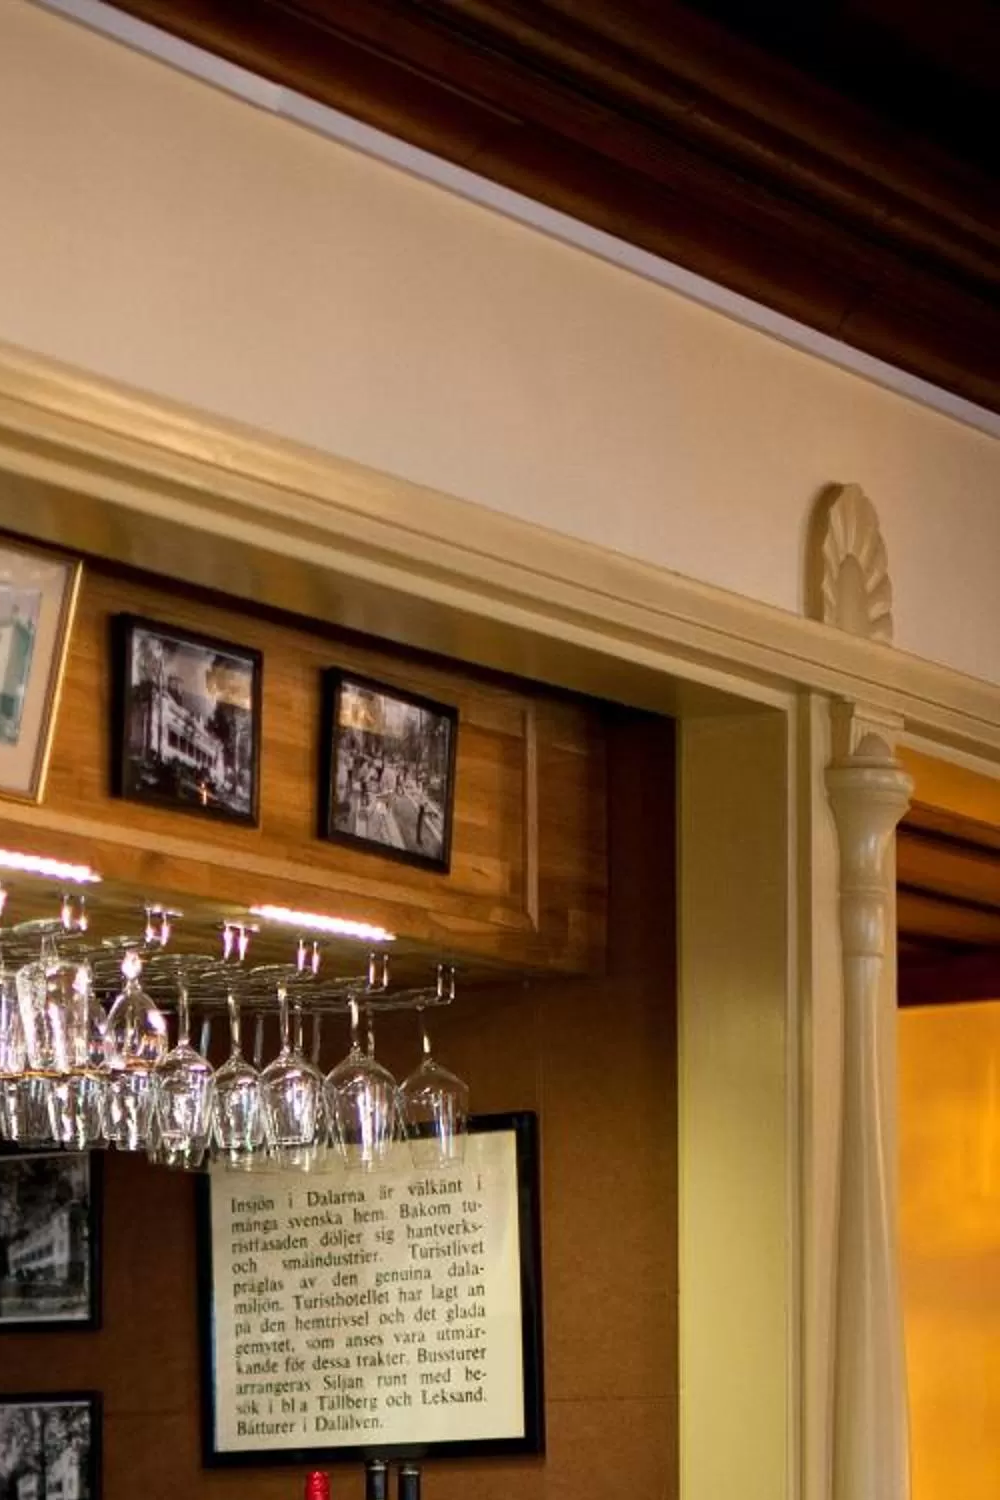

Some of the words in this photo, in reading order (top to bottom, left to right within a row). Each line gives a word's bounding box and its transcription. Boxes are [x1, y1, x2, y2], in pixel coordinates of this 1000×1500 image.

[231, 1195, 275, 1215] Insjön
[287, 1191, 293, 1209] i
[306, 1189, 365, 1208] Dalarna
[379, 1184, 394, 1201] är
[407, 1178, 462, 1197] välkänt
[475, 1174, 482, 1191] i
[286, 1210, 343, 1229] svenska
[399, 1201, 451, 1219] Bakom
[461, 1200, 483, 1213] tu-
[319, 1229, 362, 1249] döljer
[375, 1225, 395, 1245] sig
[406, 1218, 483, 1239] hantverks-
[231, 1257, 257, 1275] och
[408, 1240, 484, 1261] Turistlivet
[233, 1275, 284, 1298] präglas
[299, 1277, 317, 1289] av
[331, 1271, 358, 1288] den
[375, 1264, 432, 1287] genuina
[446, 1260, 485, 1278] dala-
[292, 1288, 390, 1310] Turisthotellet
[398, 1287, 422, 1303] har
[431, 1283, 458, 1302] lagt
[467, 1284, 485, 1298] an
[260, 1317, 286, 1333] den
[294, 1309, 369, 1331] hemtrivsel
[379, 1306, 405, 1325] och
[414, 1304, 436, 1322] det
[446, 1300, 485, 1324] glada
[305, 1338, 335, 1350] som
[345, 1334, 384, 1349] anses
[393, 1331, 425, 1344] vara
[436, 1323, 486, 1341] utmär-
[235, 1358, 279, 1375] kande
[284, 1356, 305, 1373] för
[311, 1355, 351, 1371] dessa
[417, 1345, 486, 1364] Bussturer
[235, 1379, 311, 1397] arrangeras
[323, 1374, 364, 1394] Siljan
[377, 1372, 407, 1389] runt
[419, 1366, 451, 1385] med
[464, 1366, 487, 1382] be-
[236, 1398, 259, 1416] sök
[269, 1398, 273, 1415] i
[316, 1393, 378, 1412] Tällberg
[385, 1391, 413, 1408] och
[421, 1385, 487, 1406] Leksand.
[237, 1419, 296, 1437] Båtturer
[303, 1416, 307, 1433] i
